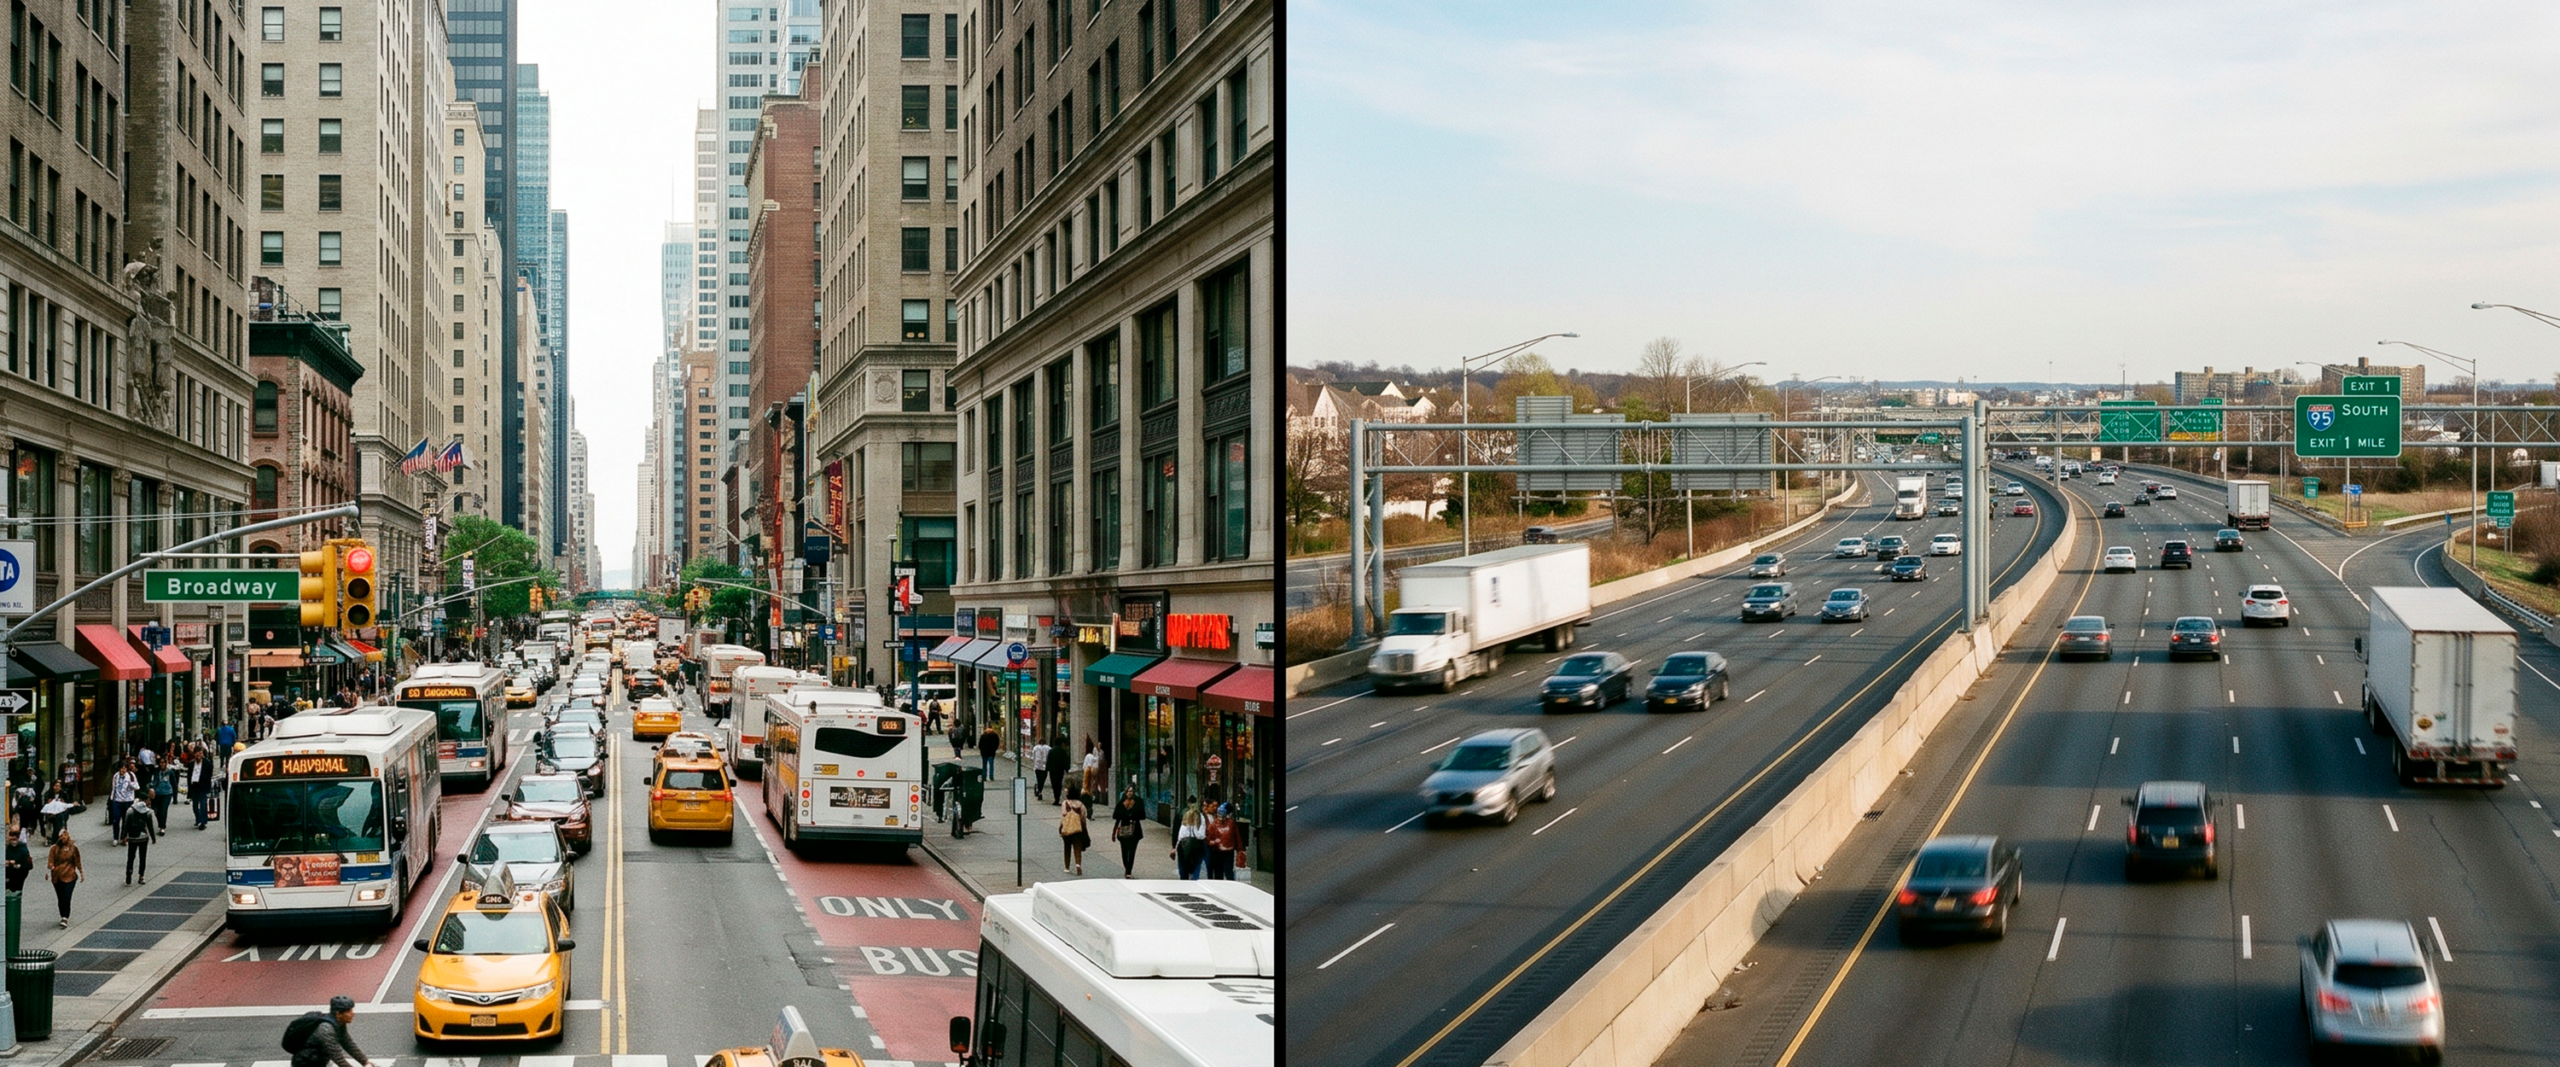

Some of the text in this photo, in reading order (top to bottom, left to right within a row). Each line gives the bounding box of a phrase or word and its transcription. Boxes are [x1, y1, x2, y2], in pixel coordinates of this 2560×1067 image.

[2350, 380, 2390, 392] EXIT 1
[2310, 411, 2332, 426] 95
[2342, 403, 2388, 416] SOUTH
[2310, 436, 2386, 449] EXIT 1 MILE
[167, 577, 278, 600] Broadway
[819, 896, 960, 921] ONLY
